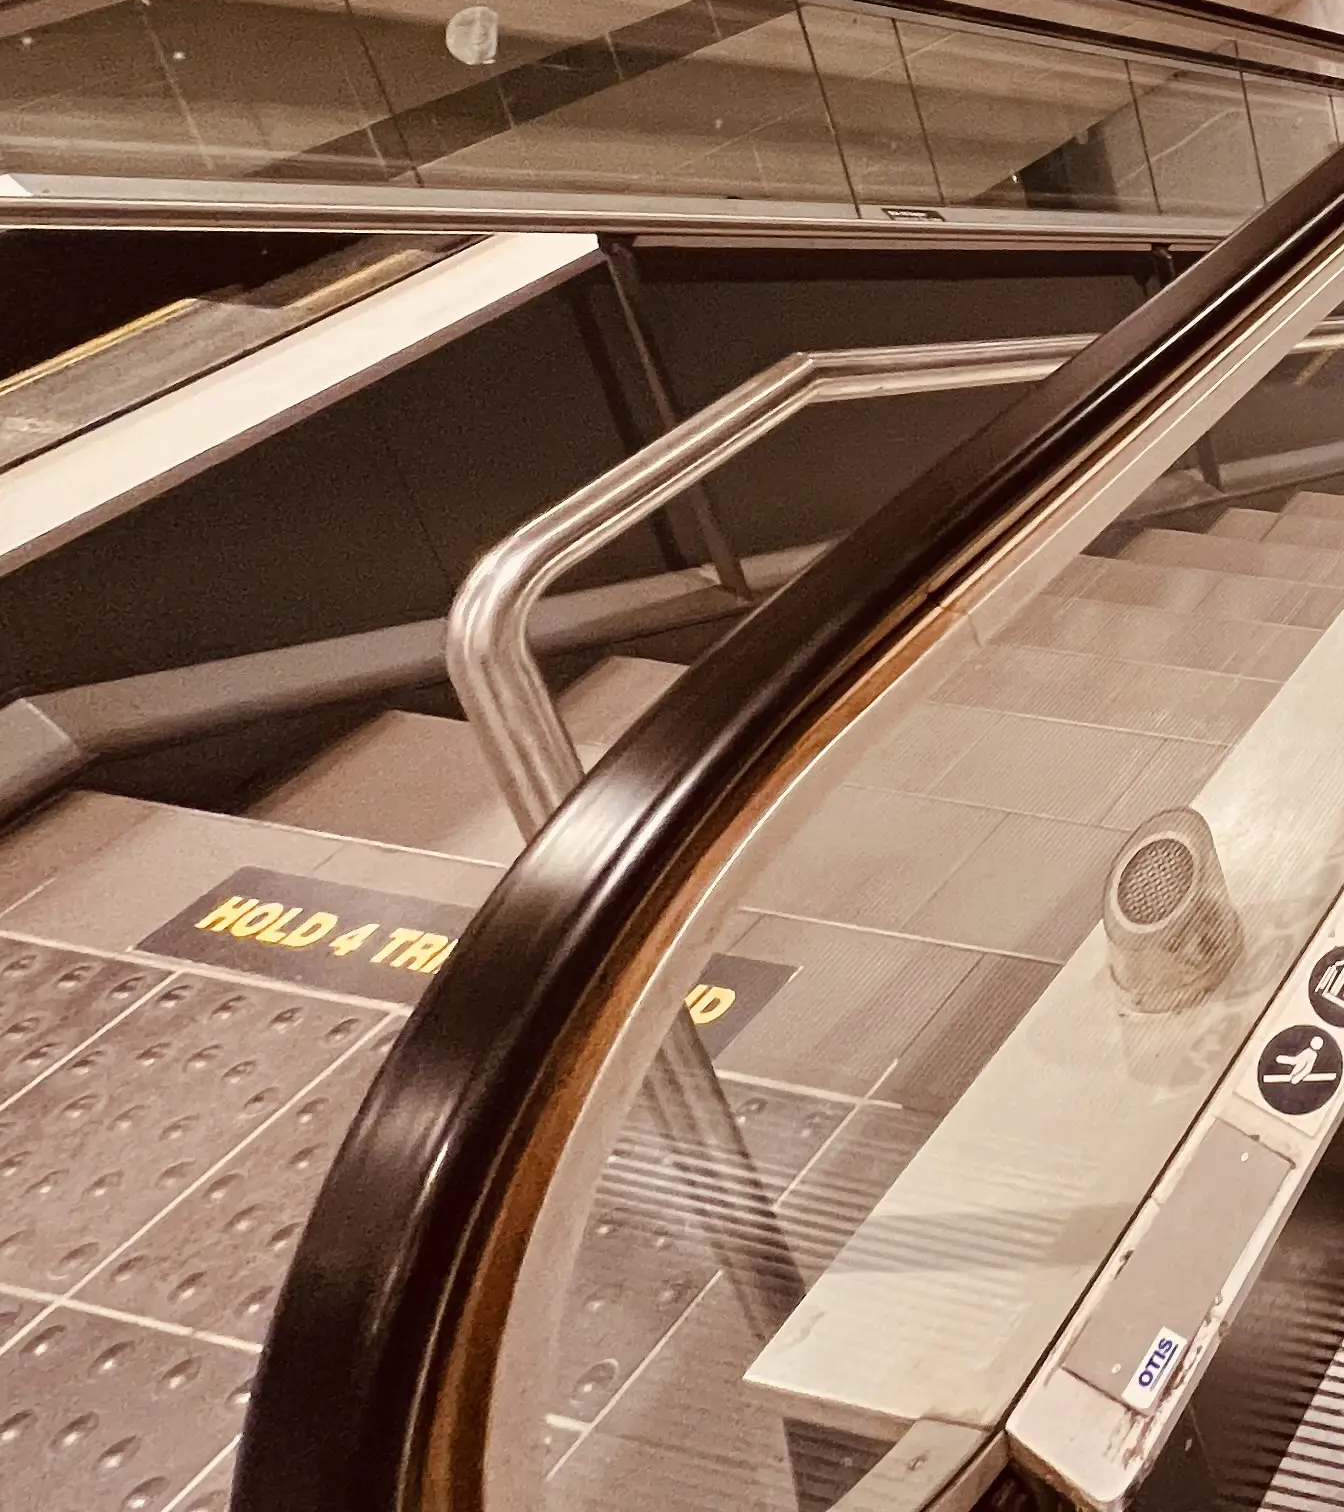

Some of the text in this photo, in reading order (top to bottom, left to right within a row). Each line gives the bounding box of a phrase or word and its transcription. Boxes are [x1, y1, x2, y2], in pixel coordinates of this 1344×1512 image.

[194, 895, 339, 949] HOLD
[328, 923, 381, 957] 4
[1138, 1337, 1173, 1387] OTIS
